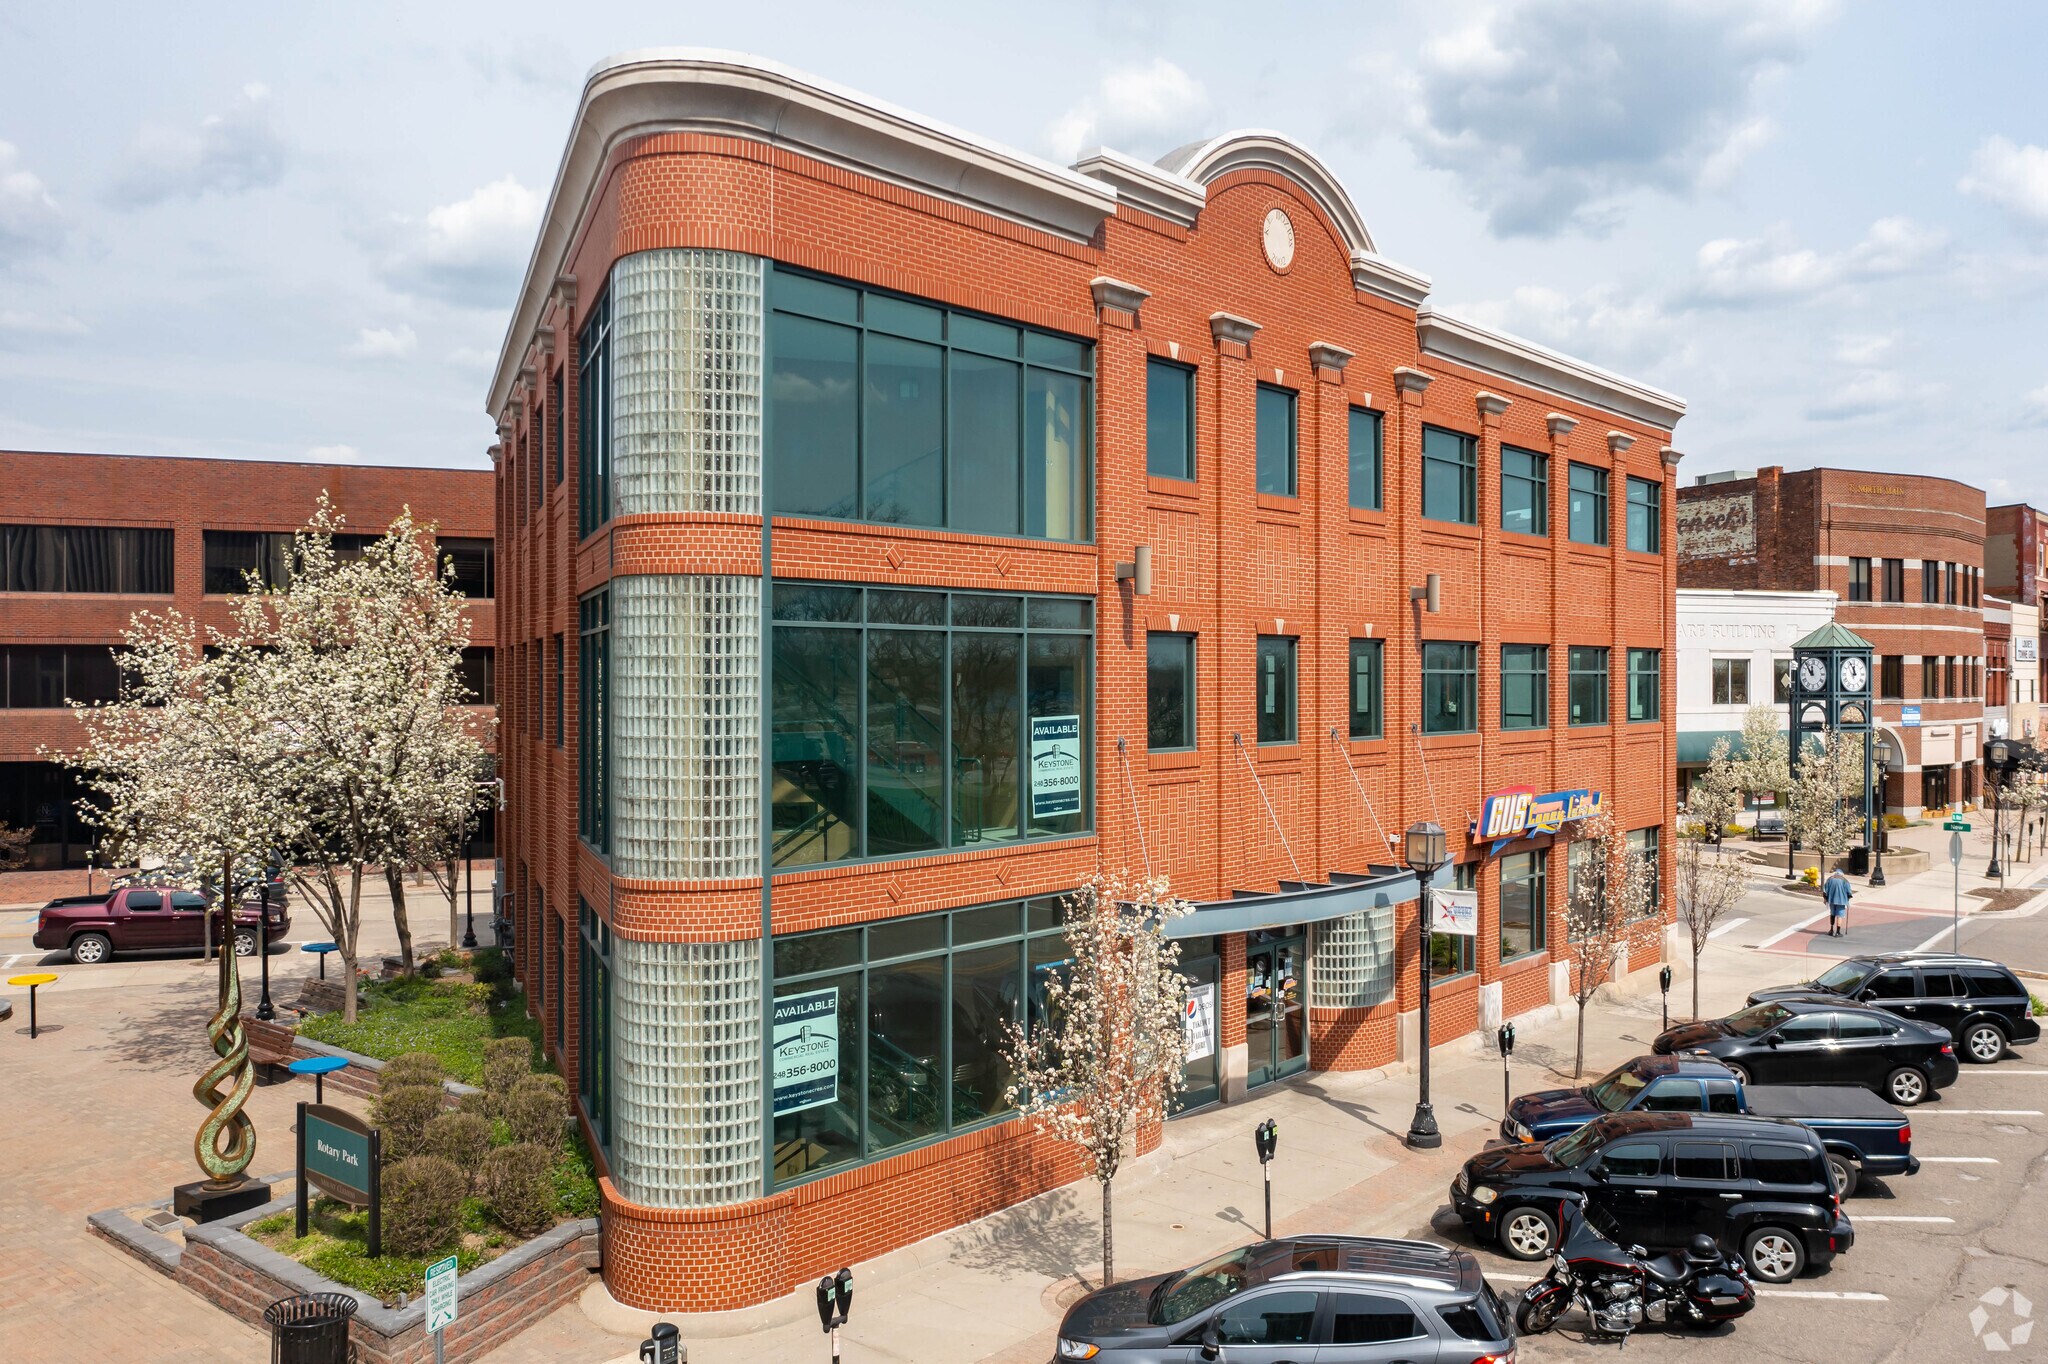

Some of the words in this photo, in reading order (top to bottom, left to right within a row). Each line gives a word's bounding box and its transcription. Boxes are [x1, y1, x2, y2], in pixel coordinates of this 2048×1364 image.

[1676, 623, 1705, 638] ARE
[1709, 623, 1776, 639] BUILDING
[1033, 724, 1078, 736] AVAILABLE
[1038, 758, 1074, 769] KEYSTONE
[1043, 775, 1079, 788] 356-8000
[774, 998, 835, 1019] AVAILABLE
[779, 1039, 830, 1058] KEYSTONE
[773, 1070, 786, 1079] 248
[786, 1058, 836, 1079] 356-8000
[317, 1138, 341, 1162] Rotary
[342, 1149, 359, 1167] Park
[432, 1273, 451, 1288] ELECTRIC
[428, 1288, 438, 1299] CAR
[437, 1280, 455, 1295] PARKING
[430, 1296, 441, 1307] ONLY
[441, 1289, 453, 1301] WHILE
[431, 1298, 453, 1315] CHARGING
